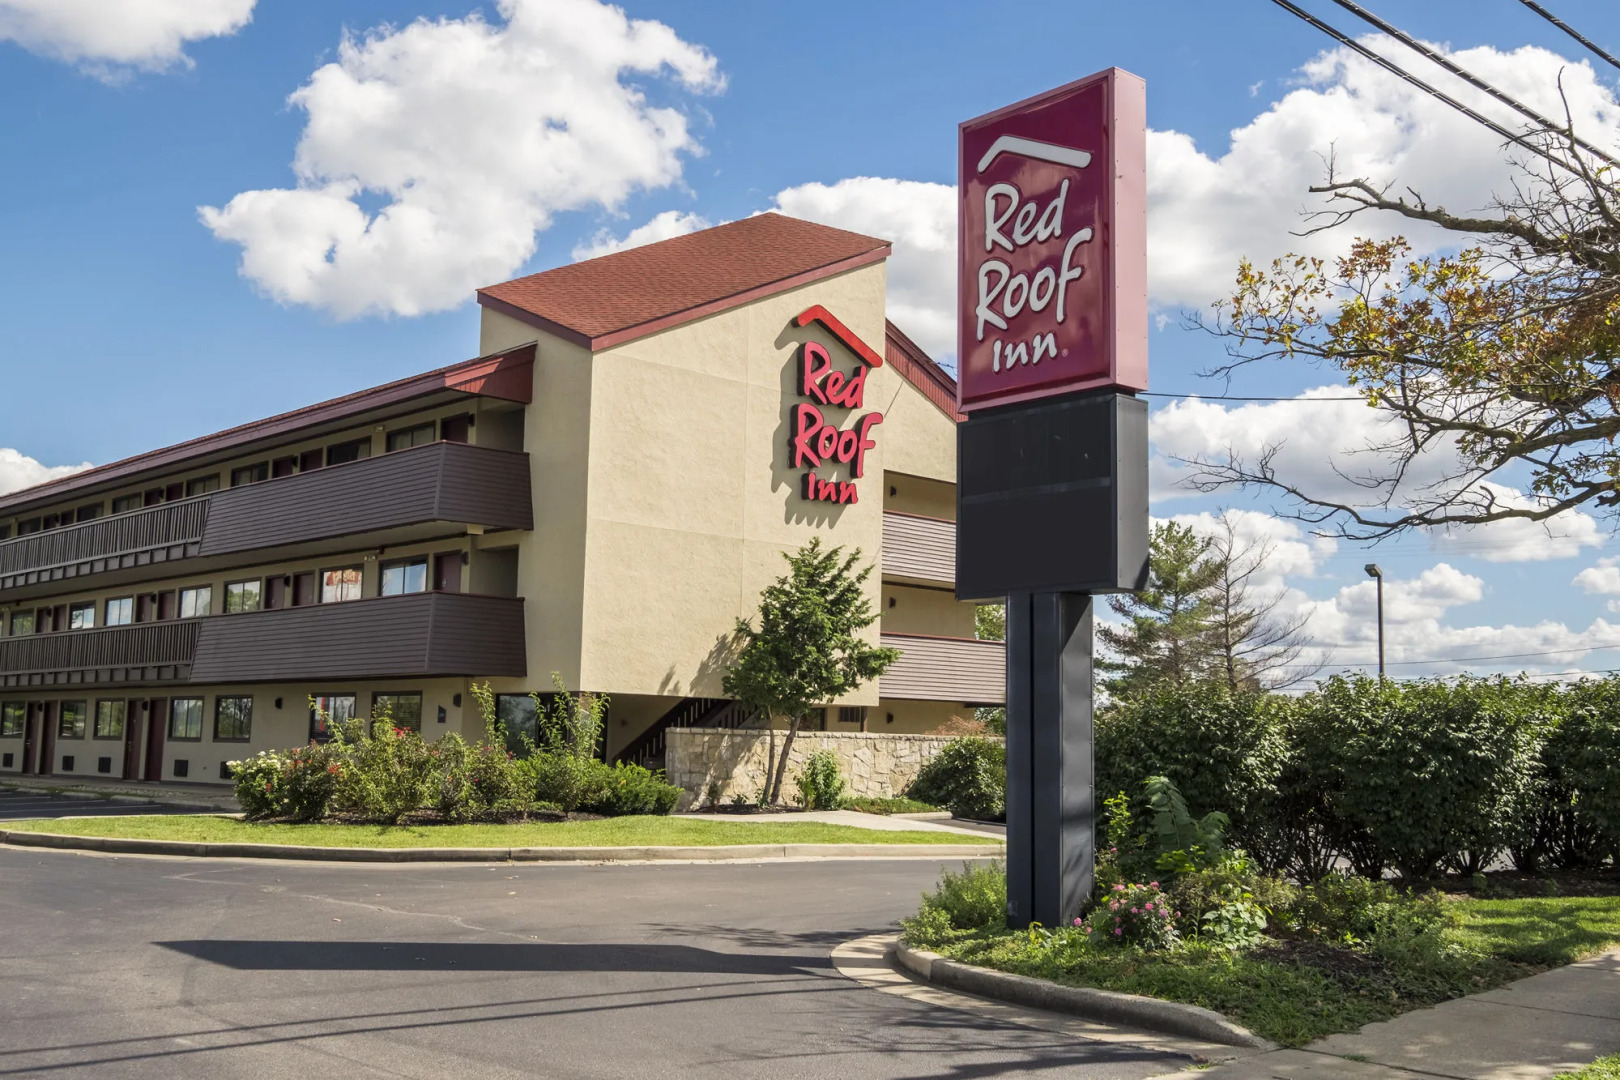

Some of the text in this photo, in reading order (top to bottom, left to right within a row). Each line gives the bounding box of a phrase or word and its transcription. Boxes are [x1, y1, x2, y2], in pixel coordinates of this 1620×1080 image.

[985, 178, 1070, 251] Red
[975, 227, 1093, 341] Roof
[803, 341, 867, 409] Red
[993, 332, 1058, 373] Inn
[794, 403, 884, 478] Roof
[808, 472, 859, 504] Inn
